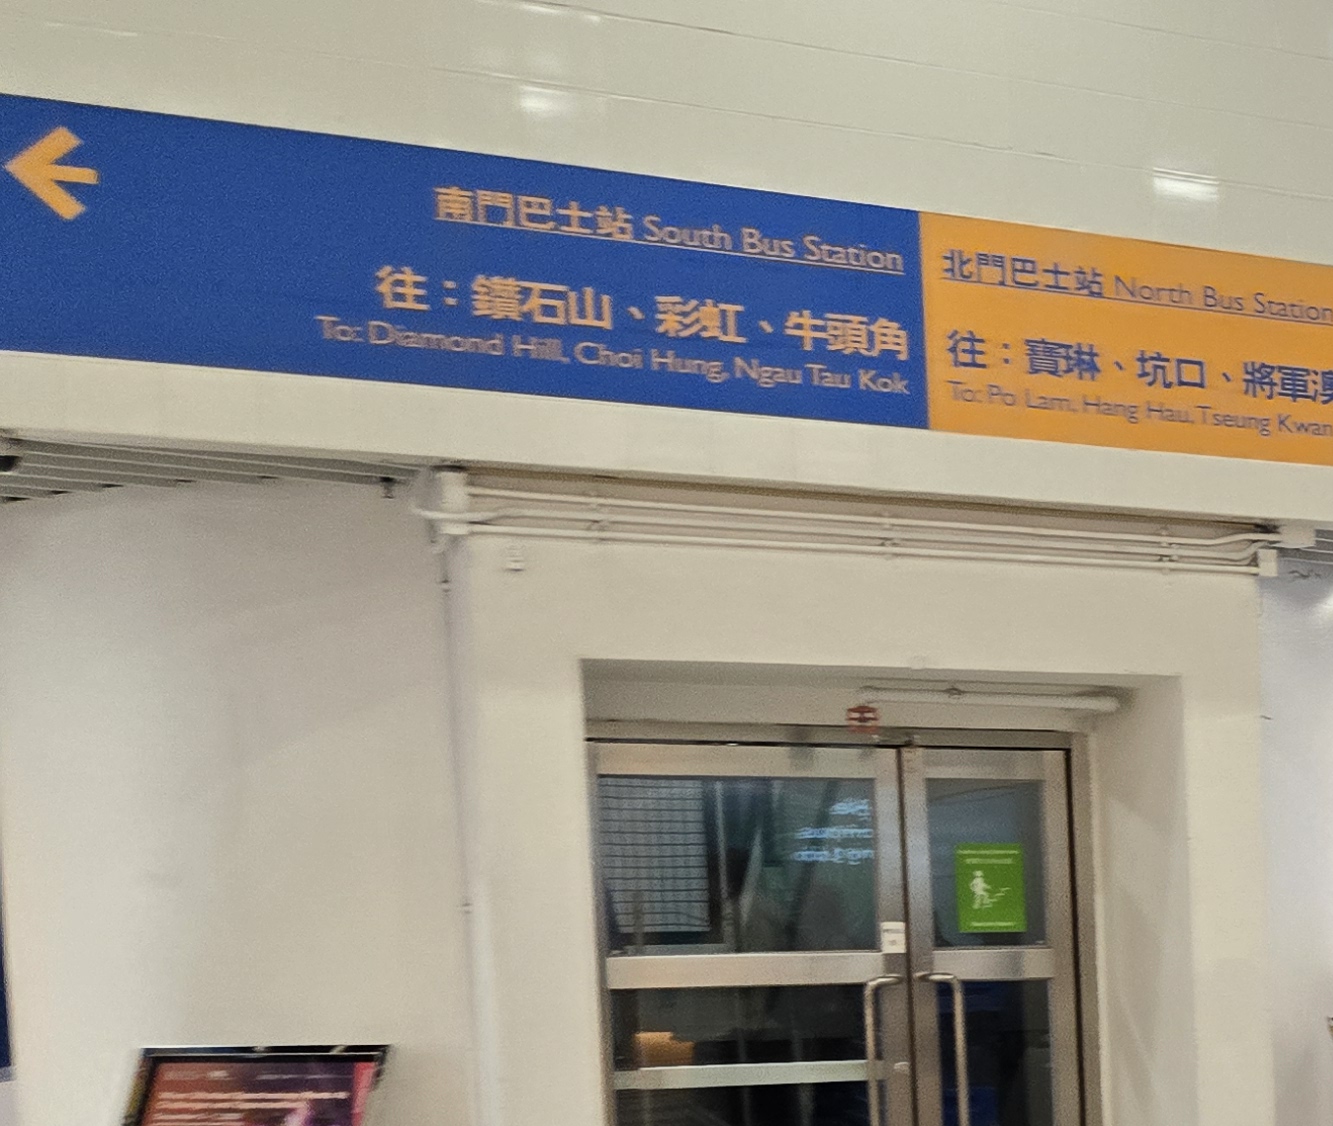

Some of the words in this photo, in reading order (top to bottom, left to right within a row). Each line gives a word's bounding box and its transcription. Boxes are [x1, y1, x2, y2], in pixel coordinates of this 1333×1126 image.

[433, 185, 633, 240] 南門巴士站
[643, 214, 732, 251] South
[741, 227, 796, 258] Bus
[803, 235, 905, 271] Station
[943, 249, 1104, 298] 北門巴士站
[1114, 274, 1194, 306] North
[1203, 285, 1244, 312] Bus
[367, 321, 503, 356] Diamond
[573, 341, 643, 370] Choi
[734, 356, 802, 388] Ngau
[805, 363, 851, 388] Tau
[858, 369, 910, 395] Kok
[986, 383, 1016, 406] Po
[1083, 394, 1139, 425] Hang
[1197, 405, 1271, 437] Tseung
[1277, 413, 1333, 437] Kwan
